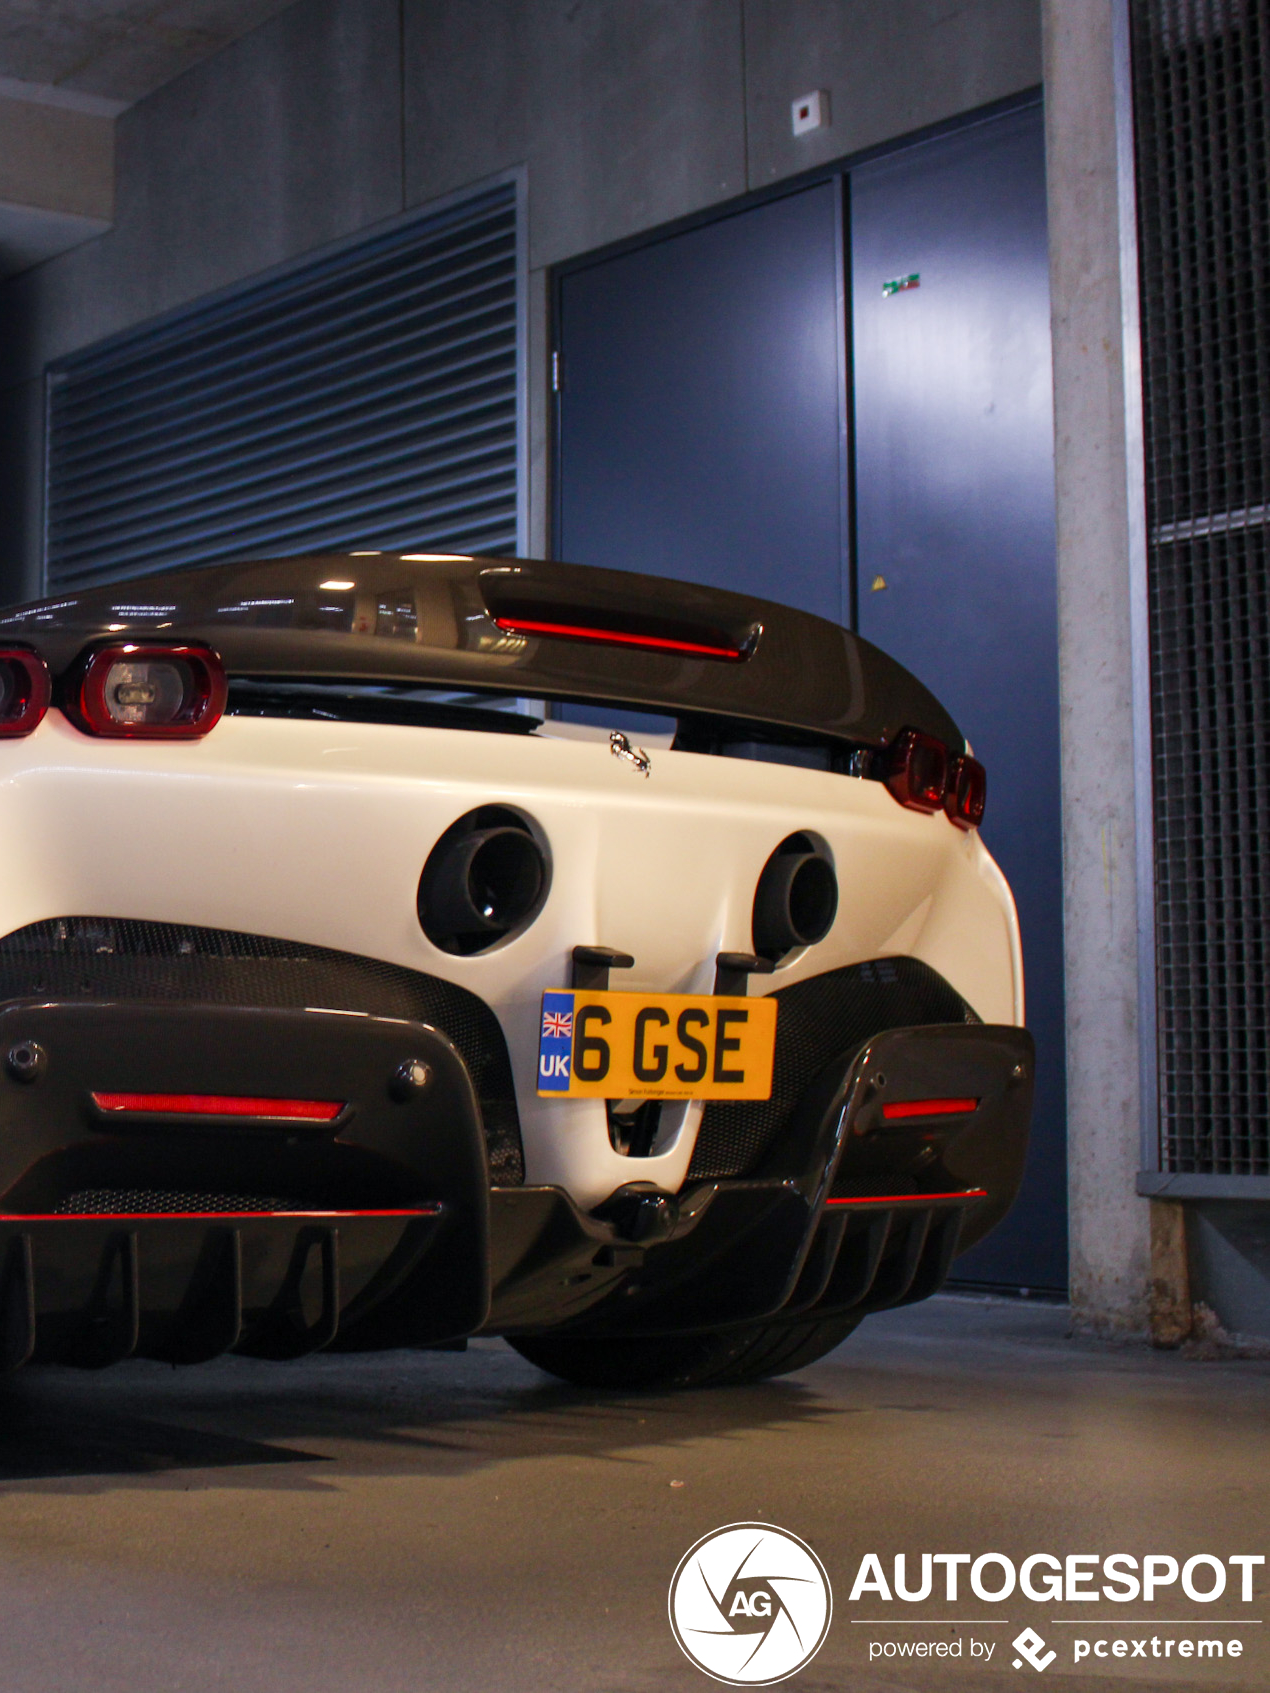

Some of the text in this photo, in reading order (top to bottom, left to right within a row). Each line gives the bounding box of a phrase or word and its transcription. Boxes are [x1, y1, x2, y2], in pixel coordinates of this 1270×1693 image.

[539, 1055, 570, 1077] UK
[573, 1005, 748, 1083] 6 GSE
